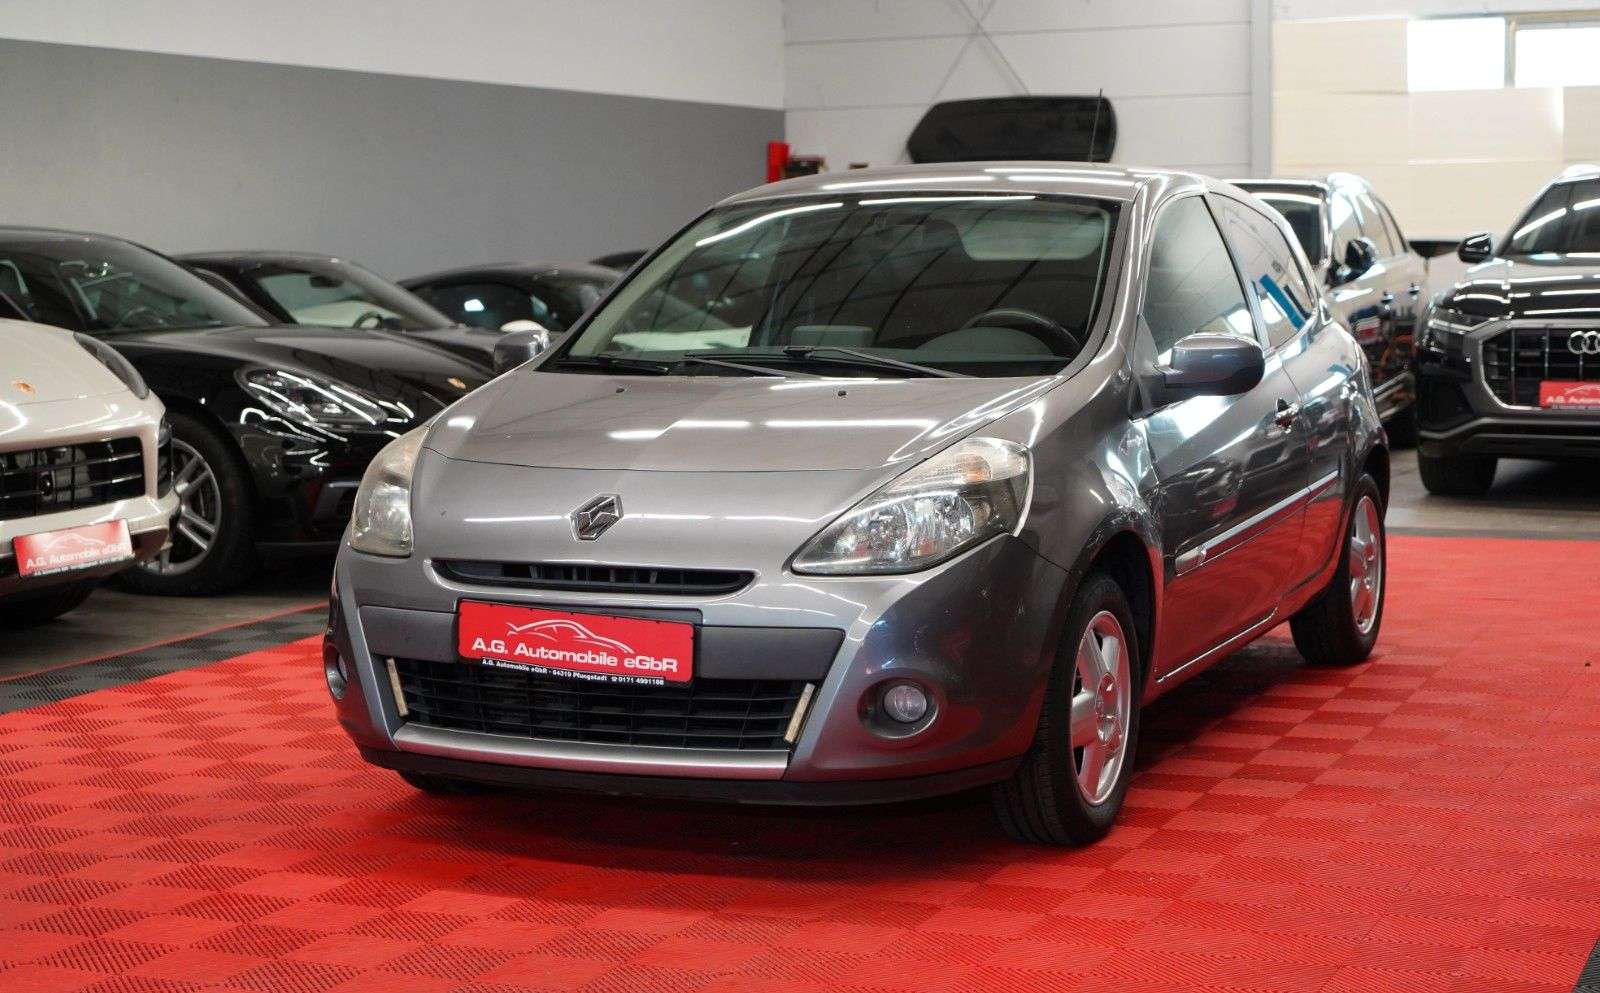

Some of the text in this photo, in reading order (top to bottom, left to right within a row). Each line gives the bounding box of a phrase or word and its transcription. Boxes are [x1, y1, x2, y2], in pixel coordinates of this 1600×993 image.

[471, 637, 679, 672] A.G. Automobile eGbR
[496, 660, 530, 672] Automobile
